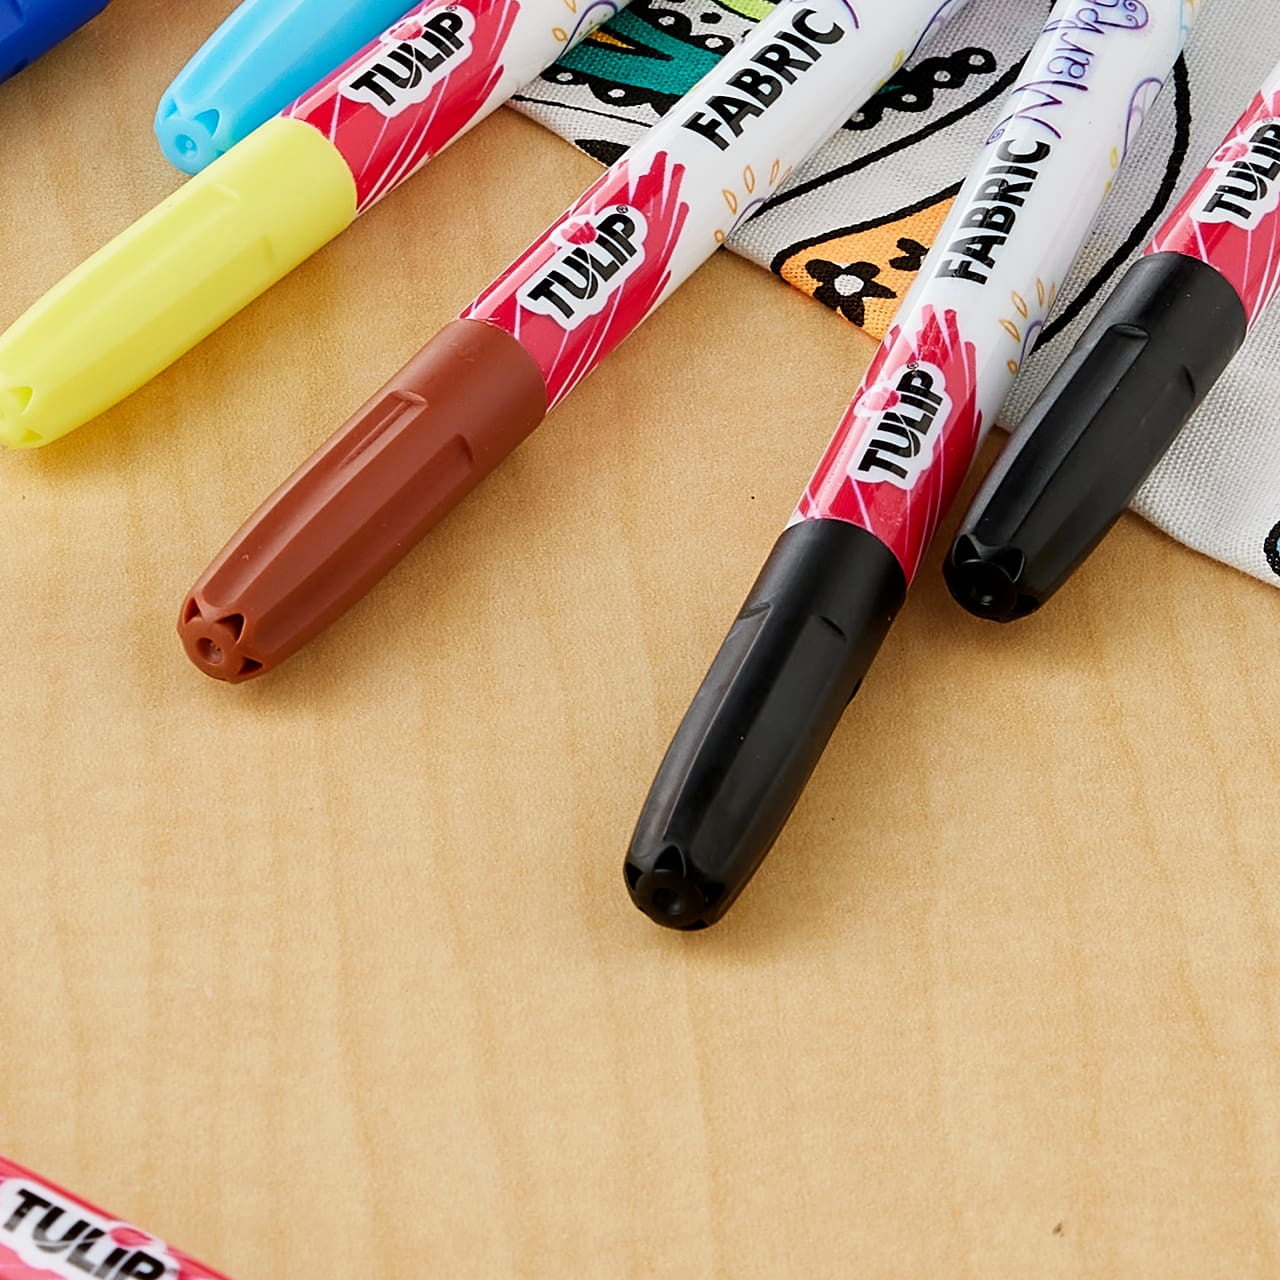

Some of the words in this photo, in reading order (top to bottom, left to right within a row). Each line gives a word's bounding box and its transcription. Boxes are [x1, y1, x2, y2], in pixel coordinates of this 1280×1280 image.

[350, 11, 465, 108] TULIP
[526, 213, 640, 320] TULIP
[682, 8, 845, 152] FABRIC
[857, 368, 944, 481] TULIP
[935, 140, 1051, 285] FABRIC
